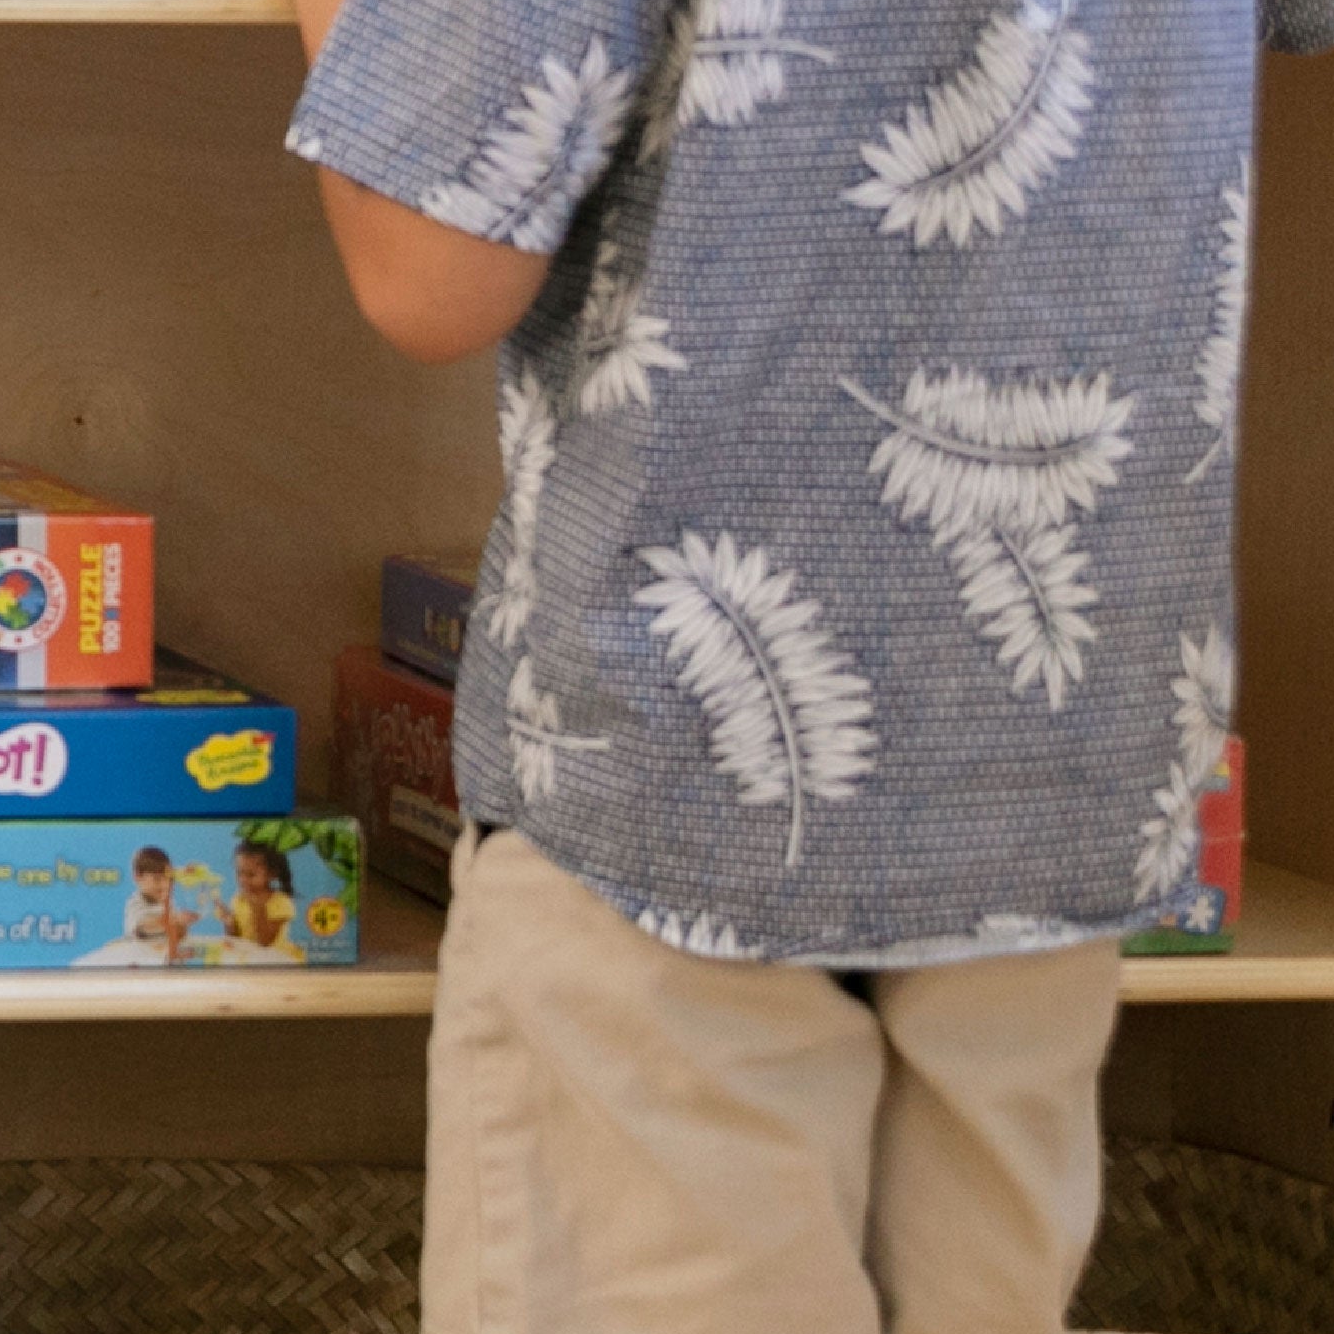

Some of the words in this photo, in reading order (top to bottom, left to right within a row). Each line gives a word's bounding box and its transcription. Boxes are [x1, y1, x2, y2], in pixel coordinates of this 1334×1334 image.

[79, 543, 103, 654] PUZZLE
[103, 543, 122, 607] PIECES
[10, 915, 36, 941] of
